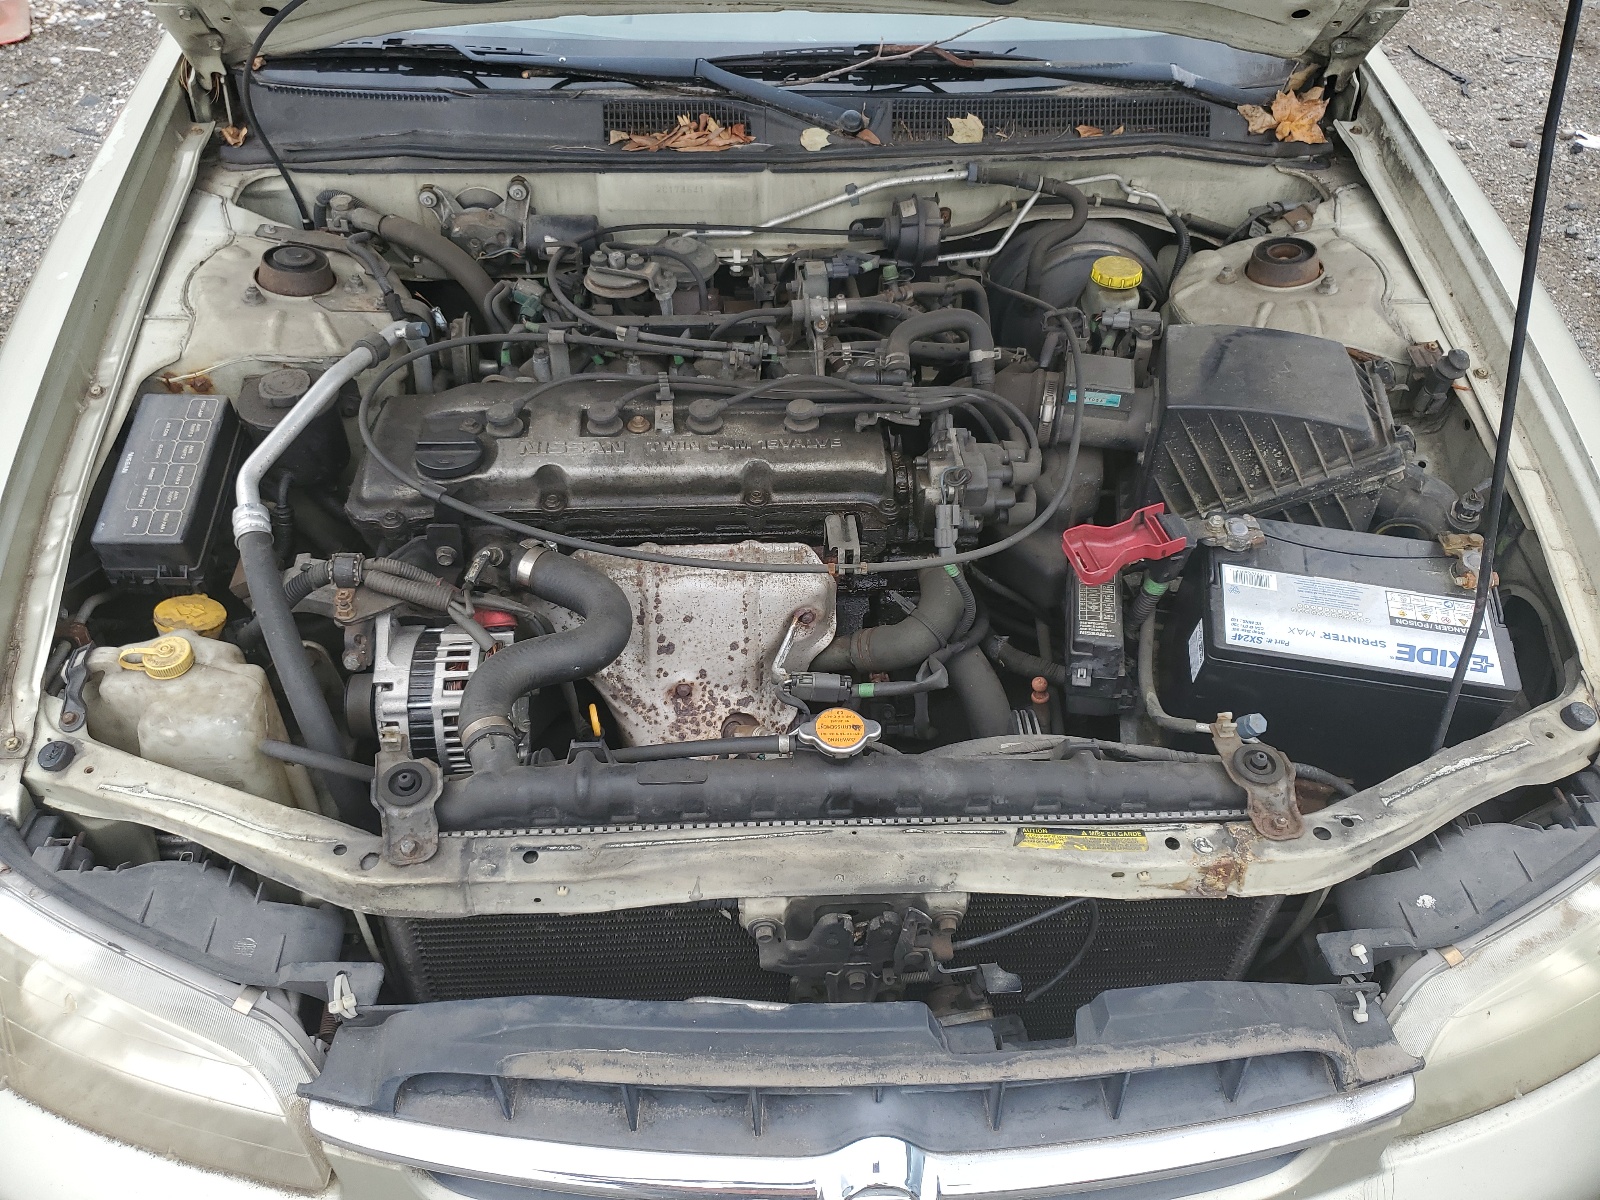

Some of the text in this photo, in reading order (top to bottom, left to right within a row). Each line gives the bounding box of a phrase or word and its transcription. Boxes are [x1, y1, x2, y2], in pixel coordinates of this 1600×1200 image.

[519, 440, 626, 455] NISSAN
[646, 440, 700, 452] TWIN
[707, 439, 751, 451] CAM
[122, 451, 135, 474] NISSAN
[1395, 618, 1429, 629] POISON
[1230, 633, 1264, 645] SX24F
[1274, 638, 1290, 647] Part
[1287, 626, 1387, 648] SPRINTER MAX
[1395, 642, 1494, 673] EXIDE
